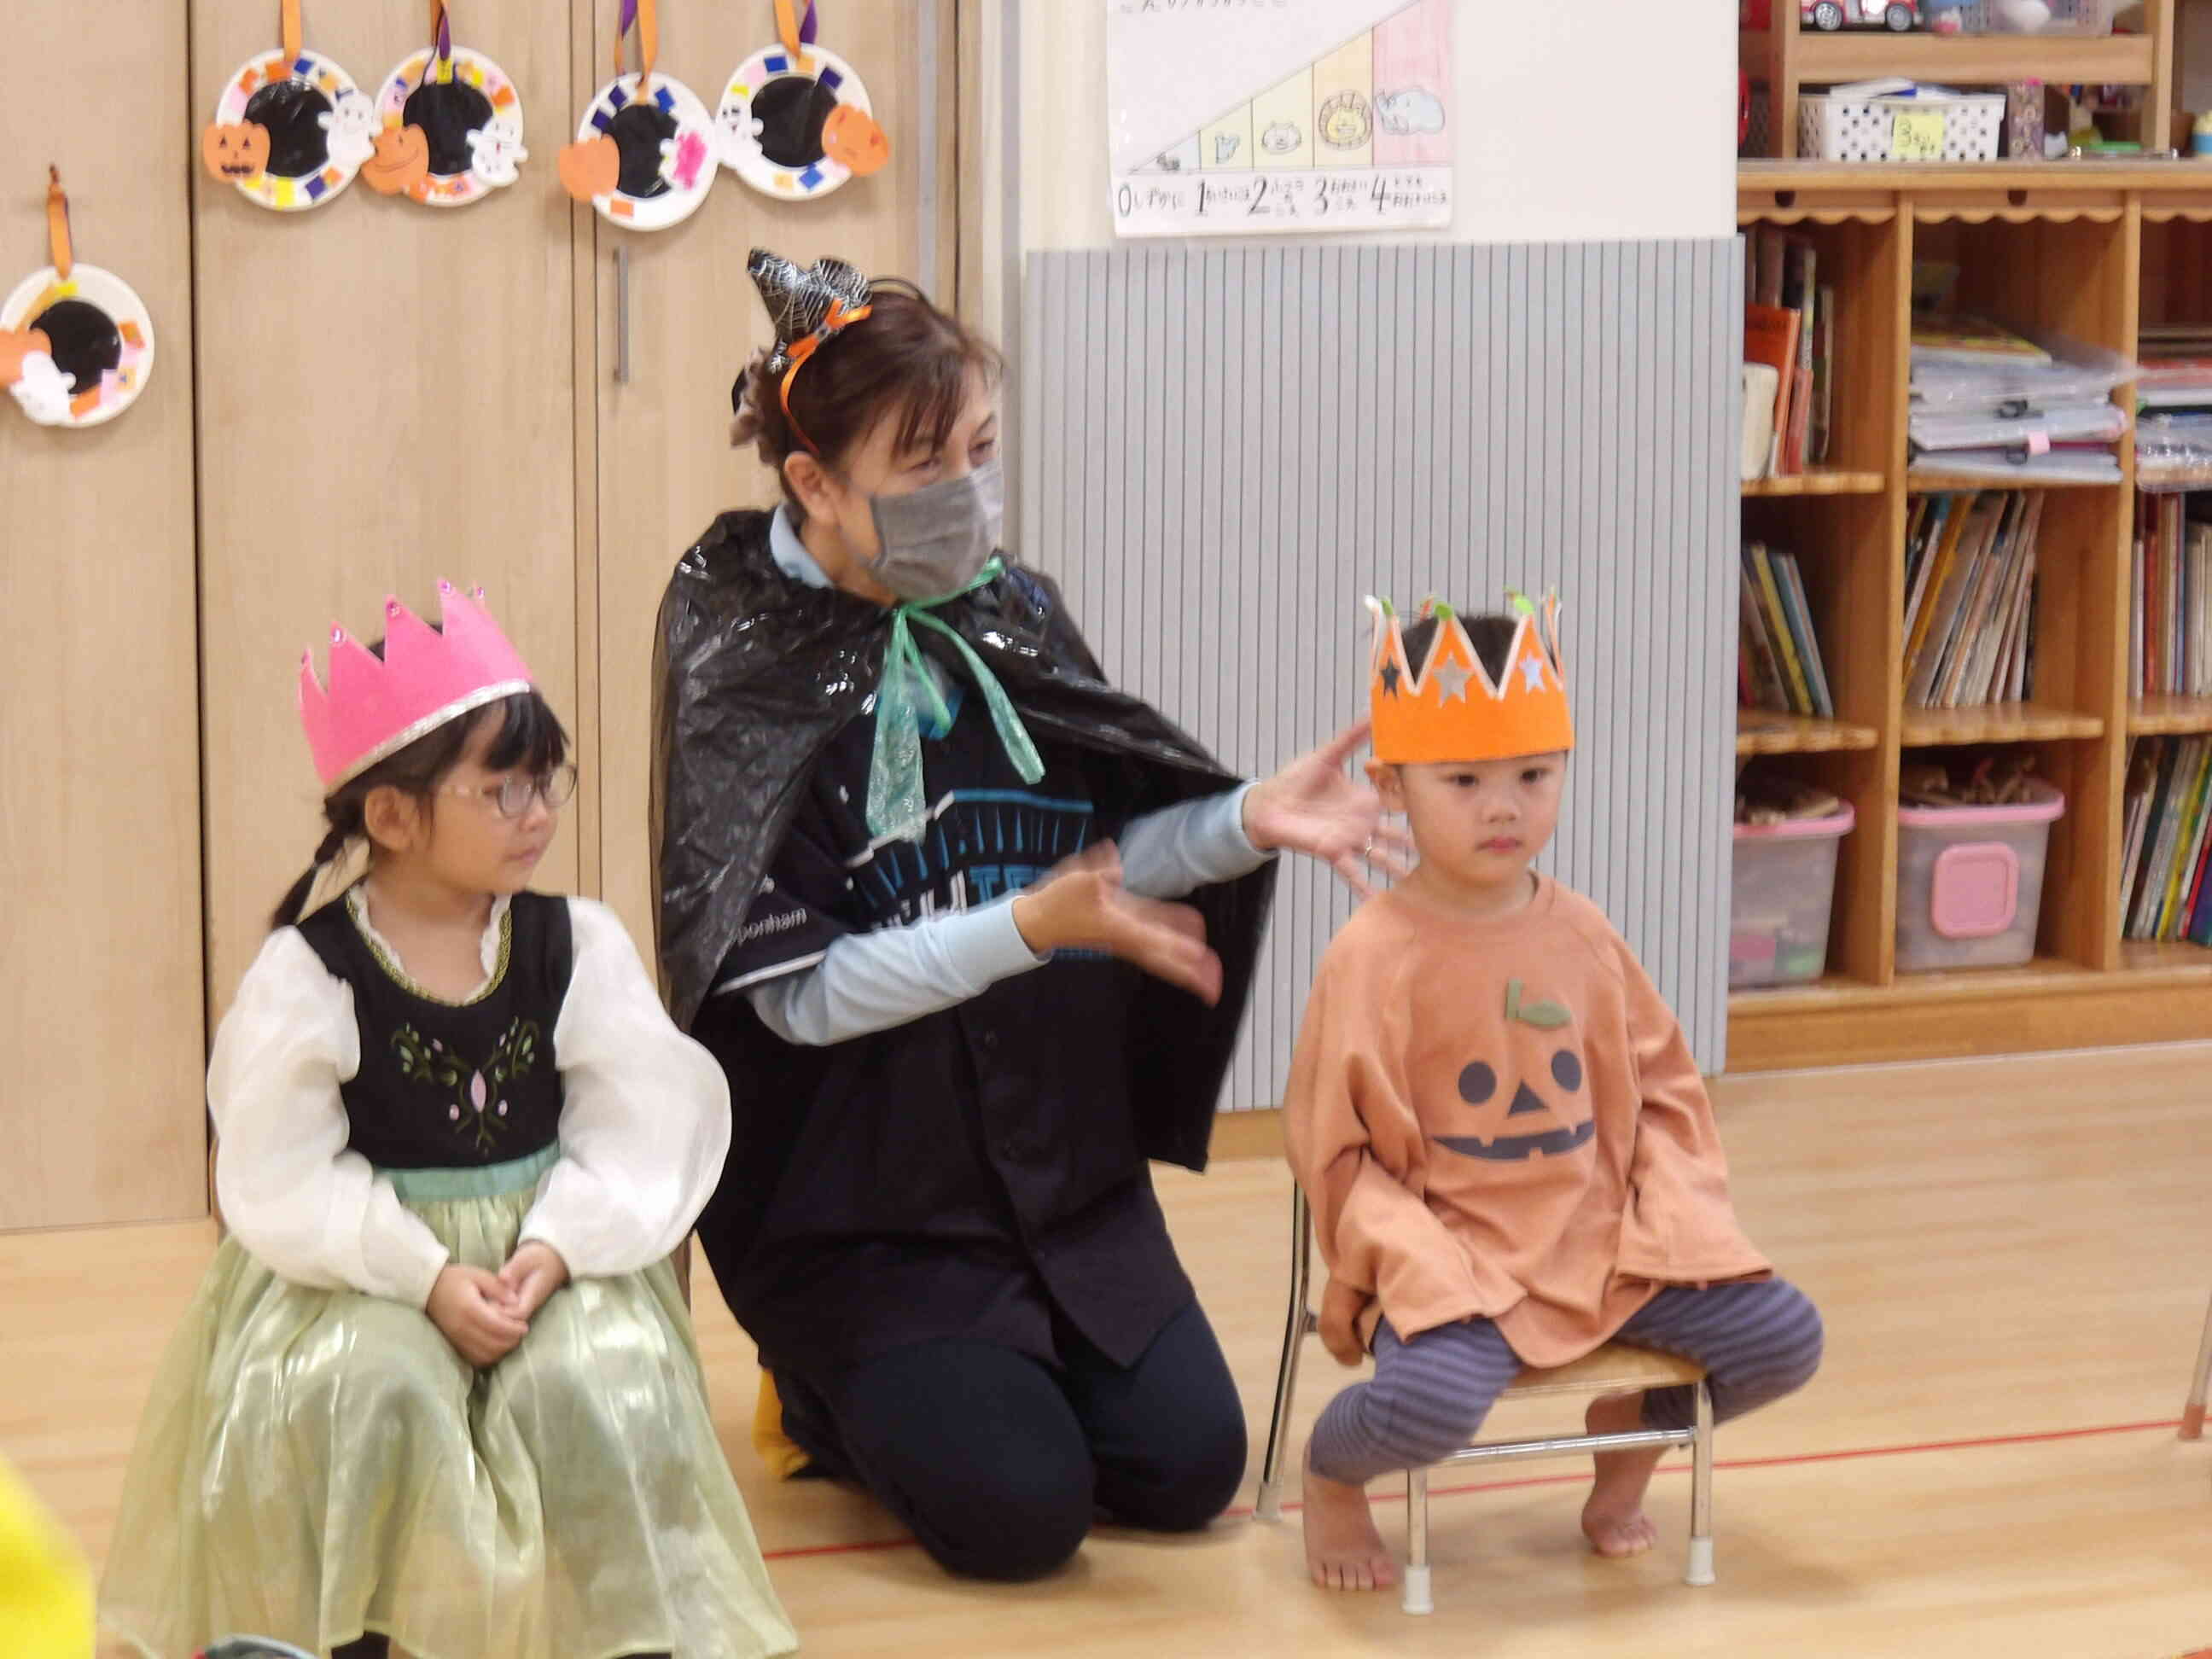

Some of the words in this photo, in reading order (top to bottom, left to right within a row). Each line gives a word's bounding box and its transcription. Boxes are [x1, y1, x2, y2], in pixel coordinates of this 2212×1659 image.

[1119, 182, 1132, 218] 0
[1196, 178, 1209, 218] 1
[1248, 176, 1271, 217] 2
[1314, 176, 1329, 216] 3
[1371, 173, 1391, 215] 4
